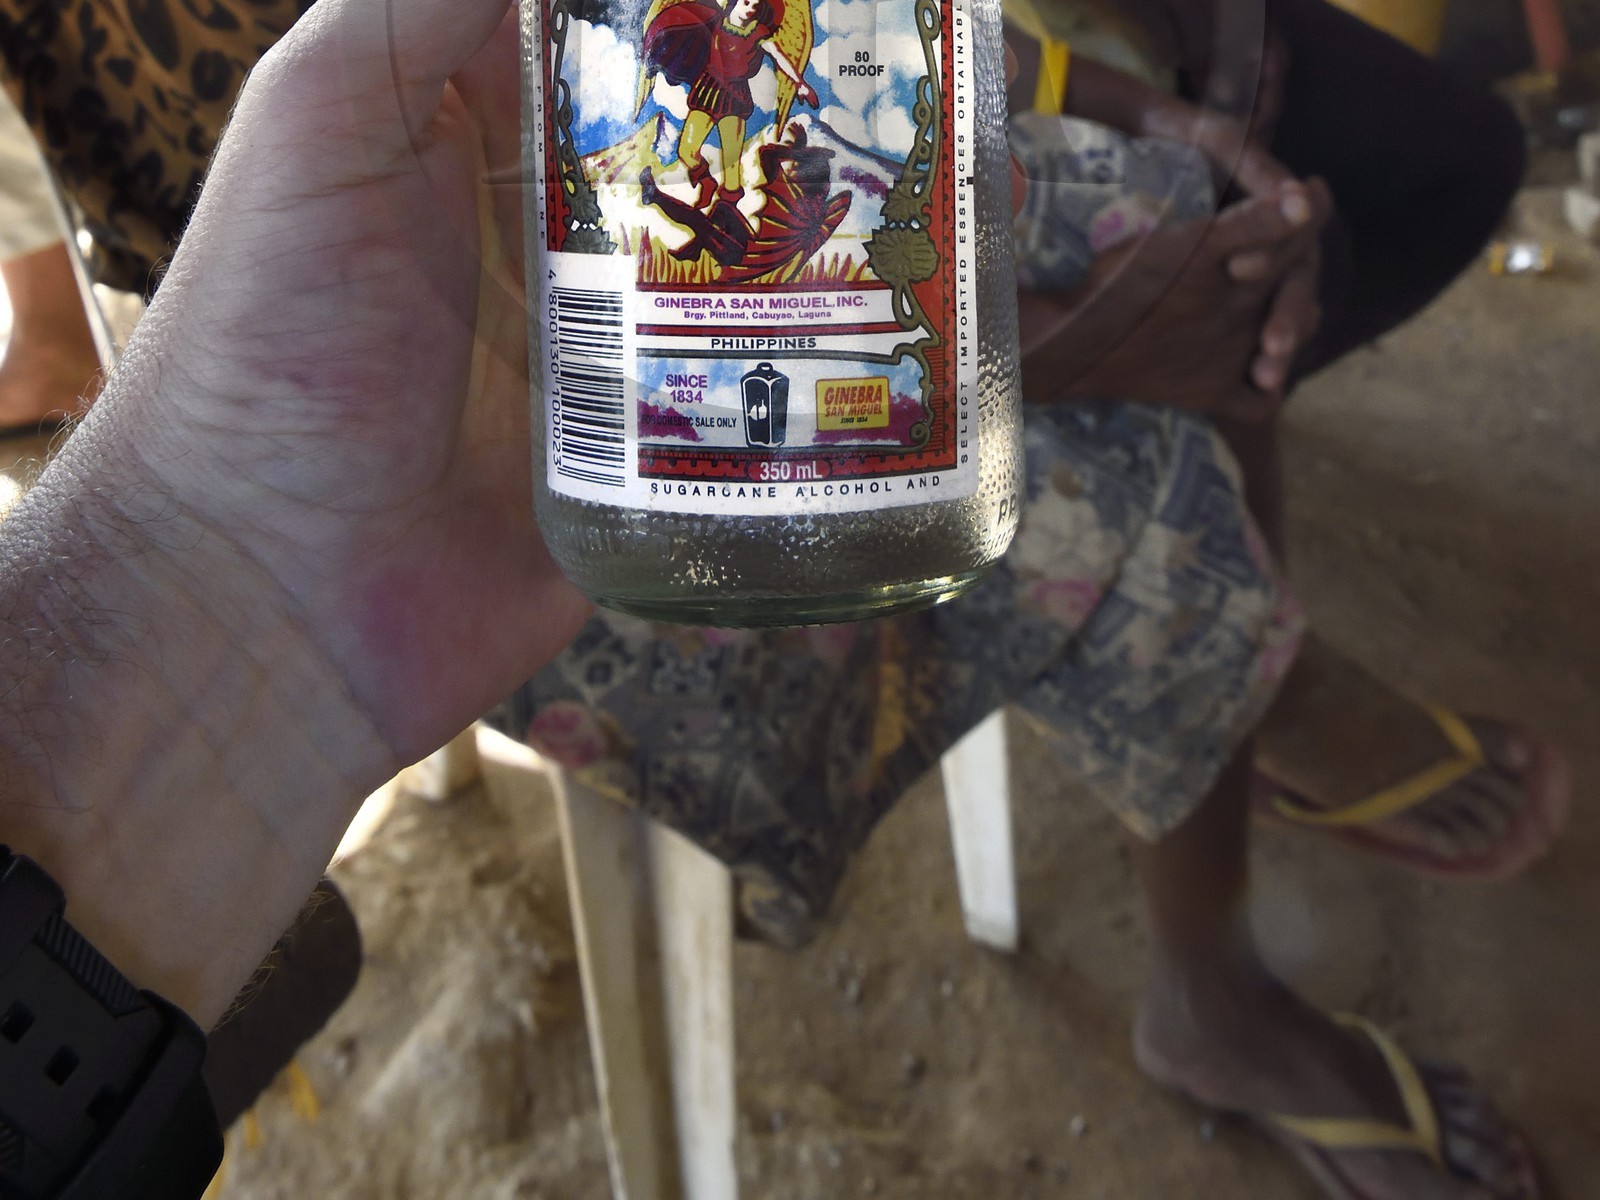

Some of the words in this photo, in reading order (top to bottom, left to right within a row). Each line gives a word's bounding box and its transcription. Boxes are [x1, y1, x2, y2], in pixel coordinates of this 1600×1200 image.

[854, 50, 870, 63] 80
[838, 64, 885, 77] PROOF
[958, 134, 966, 244] ESSENCES
[548, 268, 557, 281] 4
[654, 297, 727, 309] GINEBRA
[730, 297, 764, 309] SAN
[684, 311, 707, 321] Brgy.
[709, 310, 749, 320] Pittland,
[752, 310, 795, 320] Cabuyao,
[798, 310, 832, 320] Laguna
[960, 258, 968, 366] IMPORTED
[548, 293, 561, 376] 800130
[711, 337, 817, 349] PHILIPPINES
[665, 374, 708, 388] SINCE
[670, 390, 704, 404] 1834
[824, 384, 883, 405] GINEBRA
[825, 404, 845, 417] SAN
[848, 403, 882, 417] MIGUEL
[551, 387, 563, 467] 100023
[641, 414, 656, 425] FOR
[657, 415, 694, 427] DOMESTIC
[695, 416, 715, 428] SALE
[716, 417, 738, 428] ONLY
[960, 382, 968, 464] SELECT
[759, 461, 791, 480] 350
[796, 461, 823, 480] mL
[650, 482, 777, 498] SUGARCANE
[795, 481, 892, 498] ALCOHOL
[906, 475, 940, 490] AND
